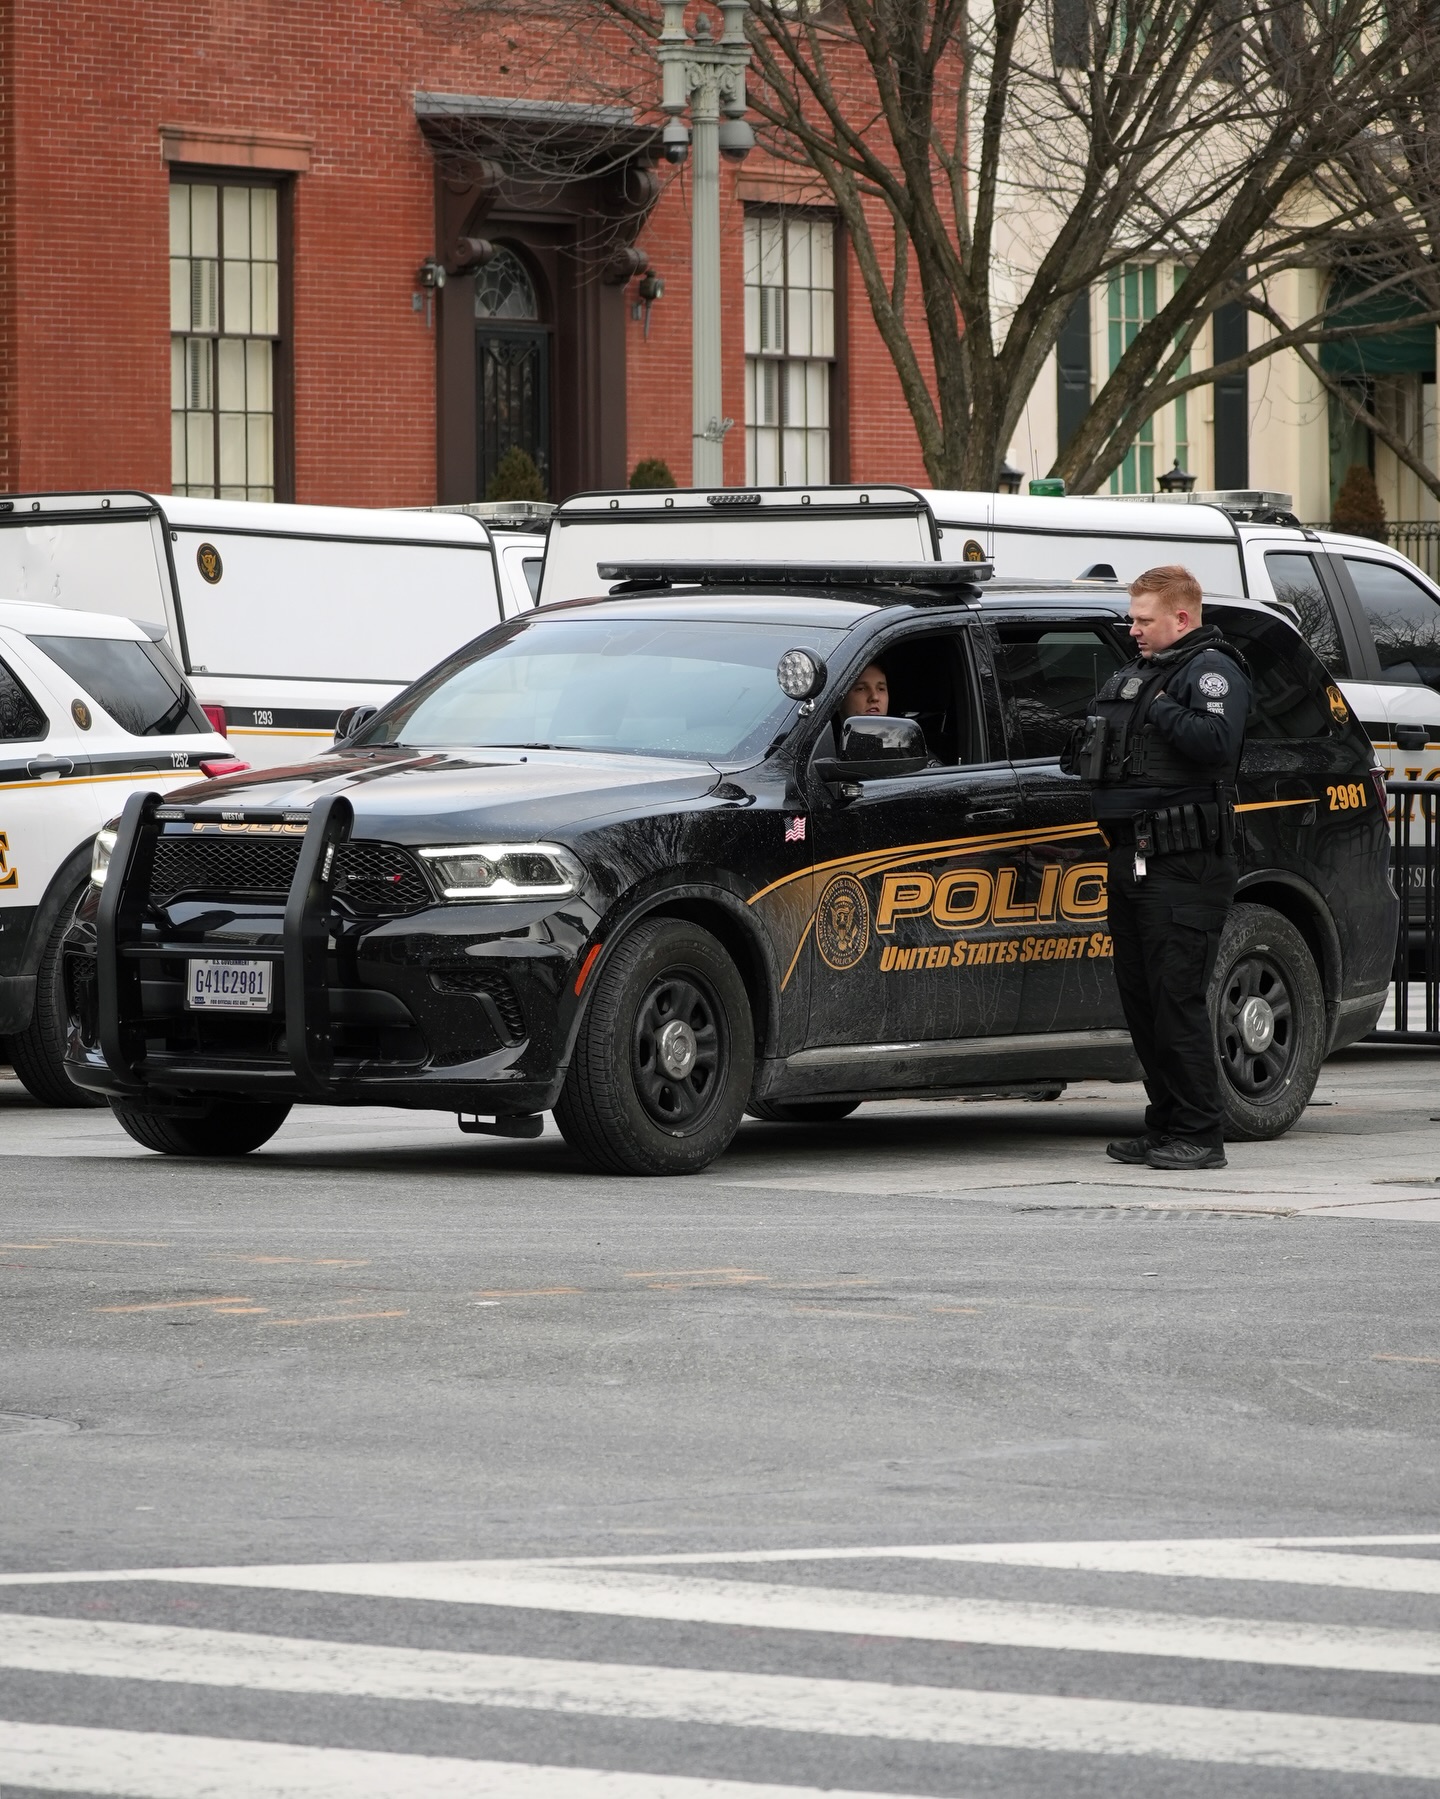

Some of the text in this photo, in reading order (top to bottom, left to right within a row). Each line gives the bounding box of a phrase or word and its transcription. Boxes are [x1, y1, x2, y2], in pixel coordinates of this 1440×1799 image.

[252, 710, 274, 726] 1293
[170, 752, 190, 769] 1252
[1326, 783, 1367, 811] 2981
[875, 862, 1109, 935] POLIC
[832, 955, 853, 965] POLICE
[879, 946, 951, 972] UNITED
[951, 940, 1020, 967] STATES
[1020, 936, 1089, 963] SECRET
[196, 969, 263, 994] G41C2981
